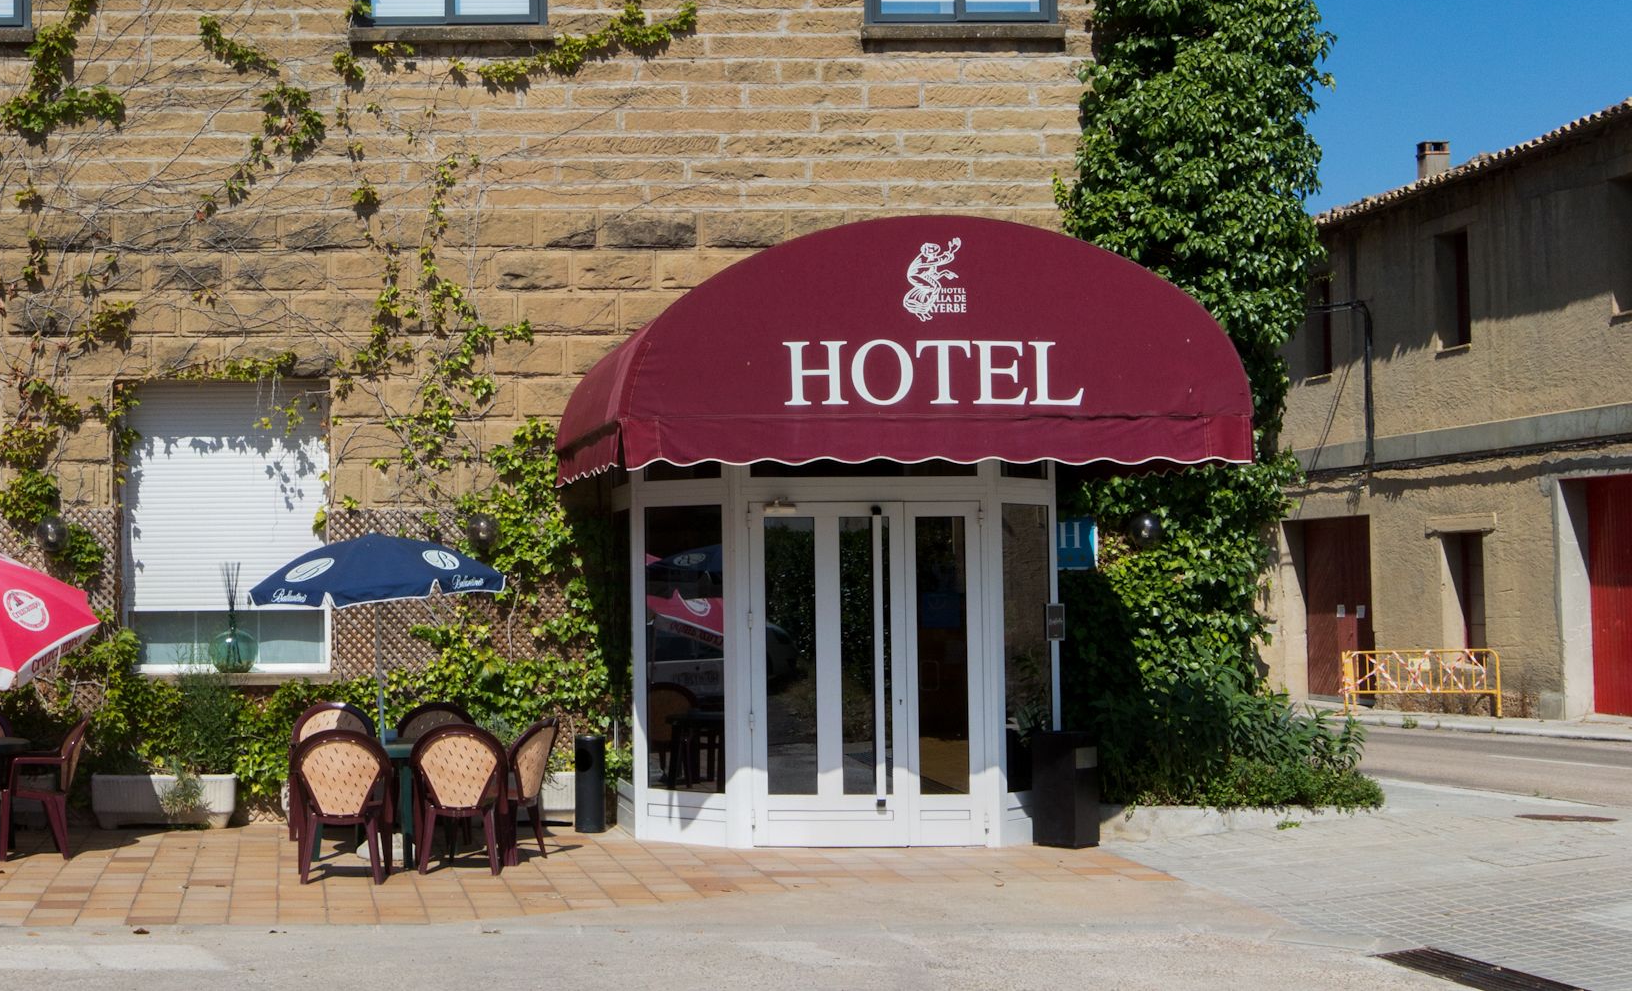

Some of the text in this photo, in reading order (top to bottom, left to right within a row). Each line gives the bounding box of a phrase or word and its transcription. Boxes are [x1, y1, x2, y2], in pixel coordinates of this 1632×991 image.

[954, 295, 967, 303] DE
[782, 339, 1084, 406] HOTEL
[1058, 521, 1082, 549] H
